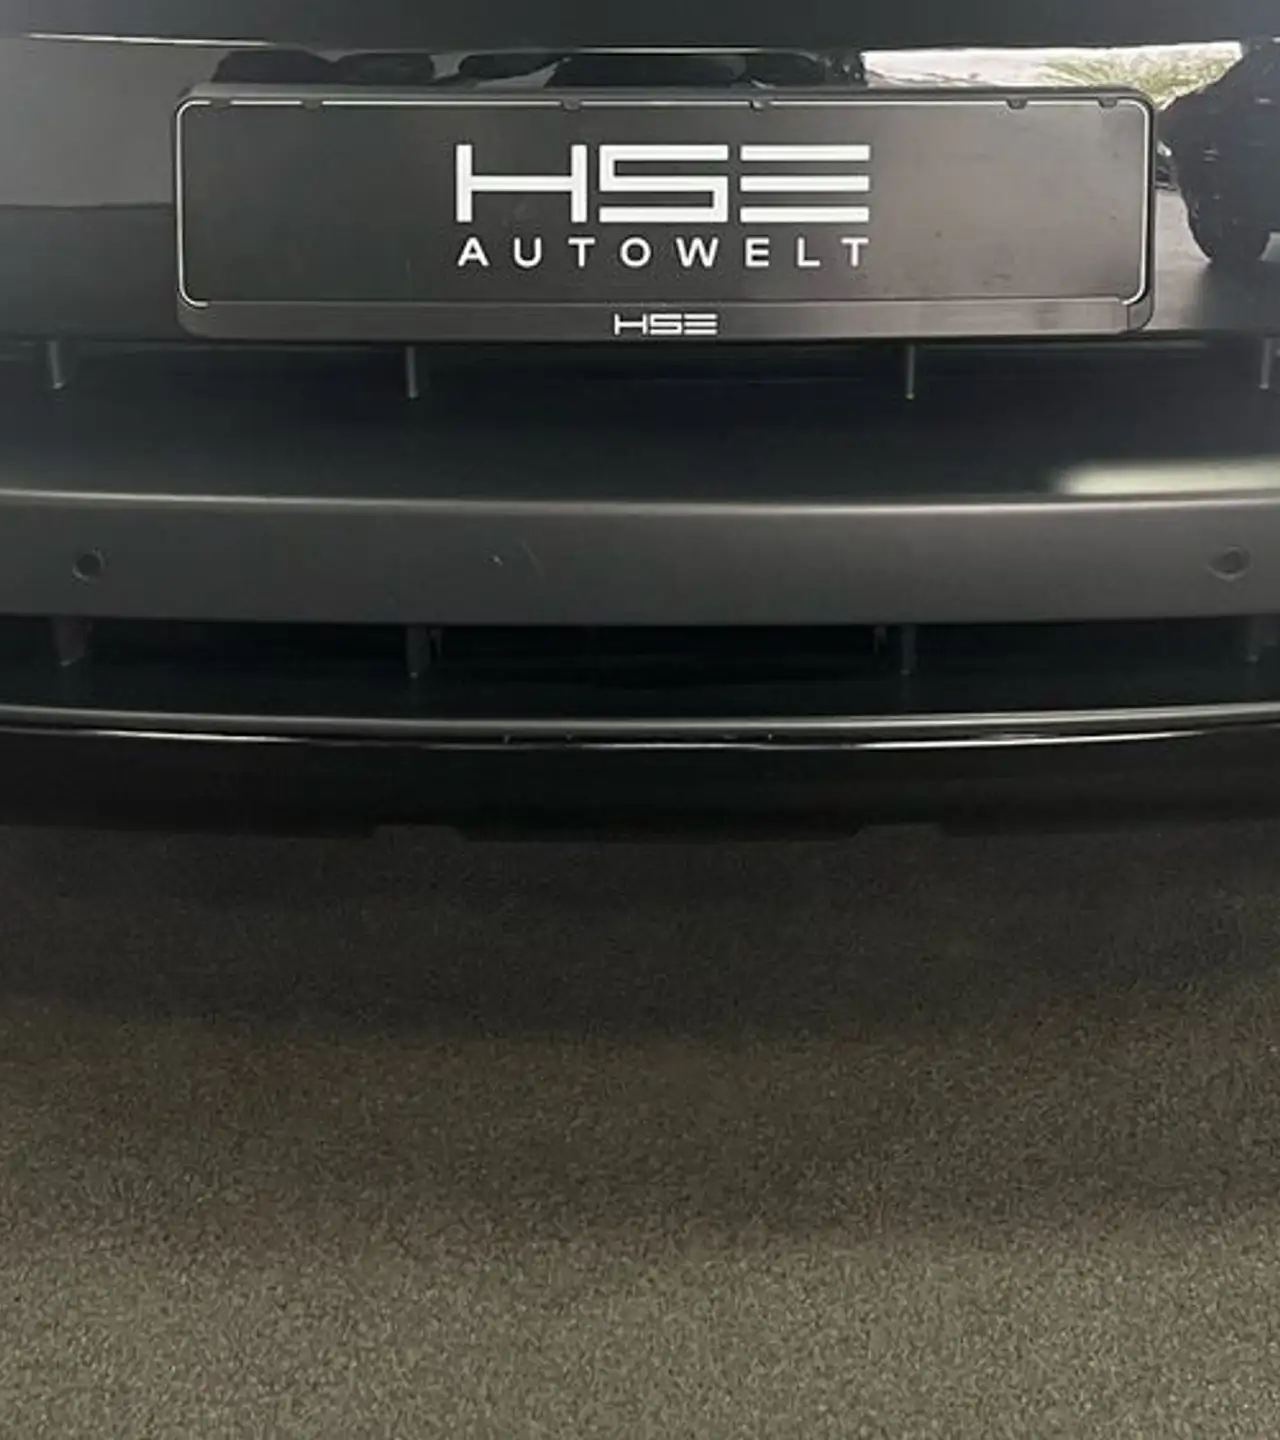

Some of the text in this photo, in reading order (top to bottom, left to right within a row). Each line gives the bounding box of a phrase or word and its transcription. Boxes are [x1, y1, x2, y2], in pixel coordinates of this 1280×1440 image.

[457, 144, 871, 223] HSE
[458, 237, 870, 268] AUTOWELT
[614, 313, 718, 335] HSE
